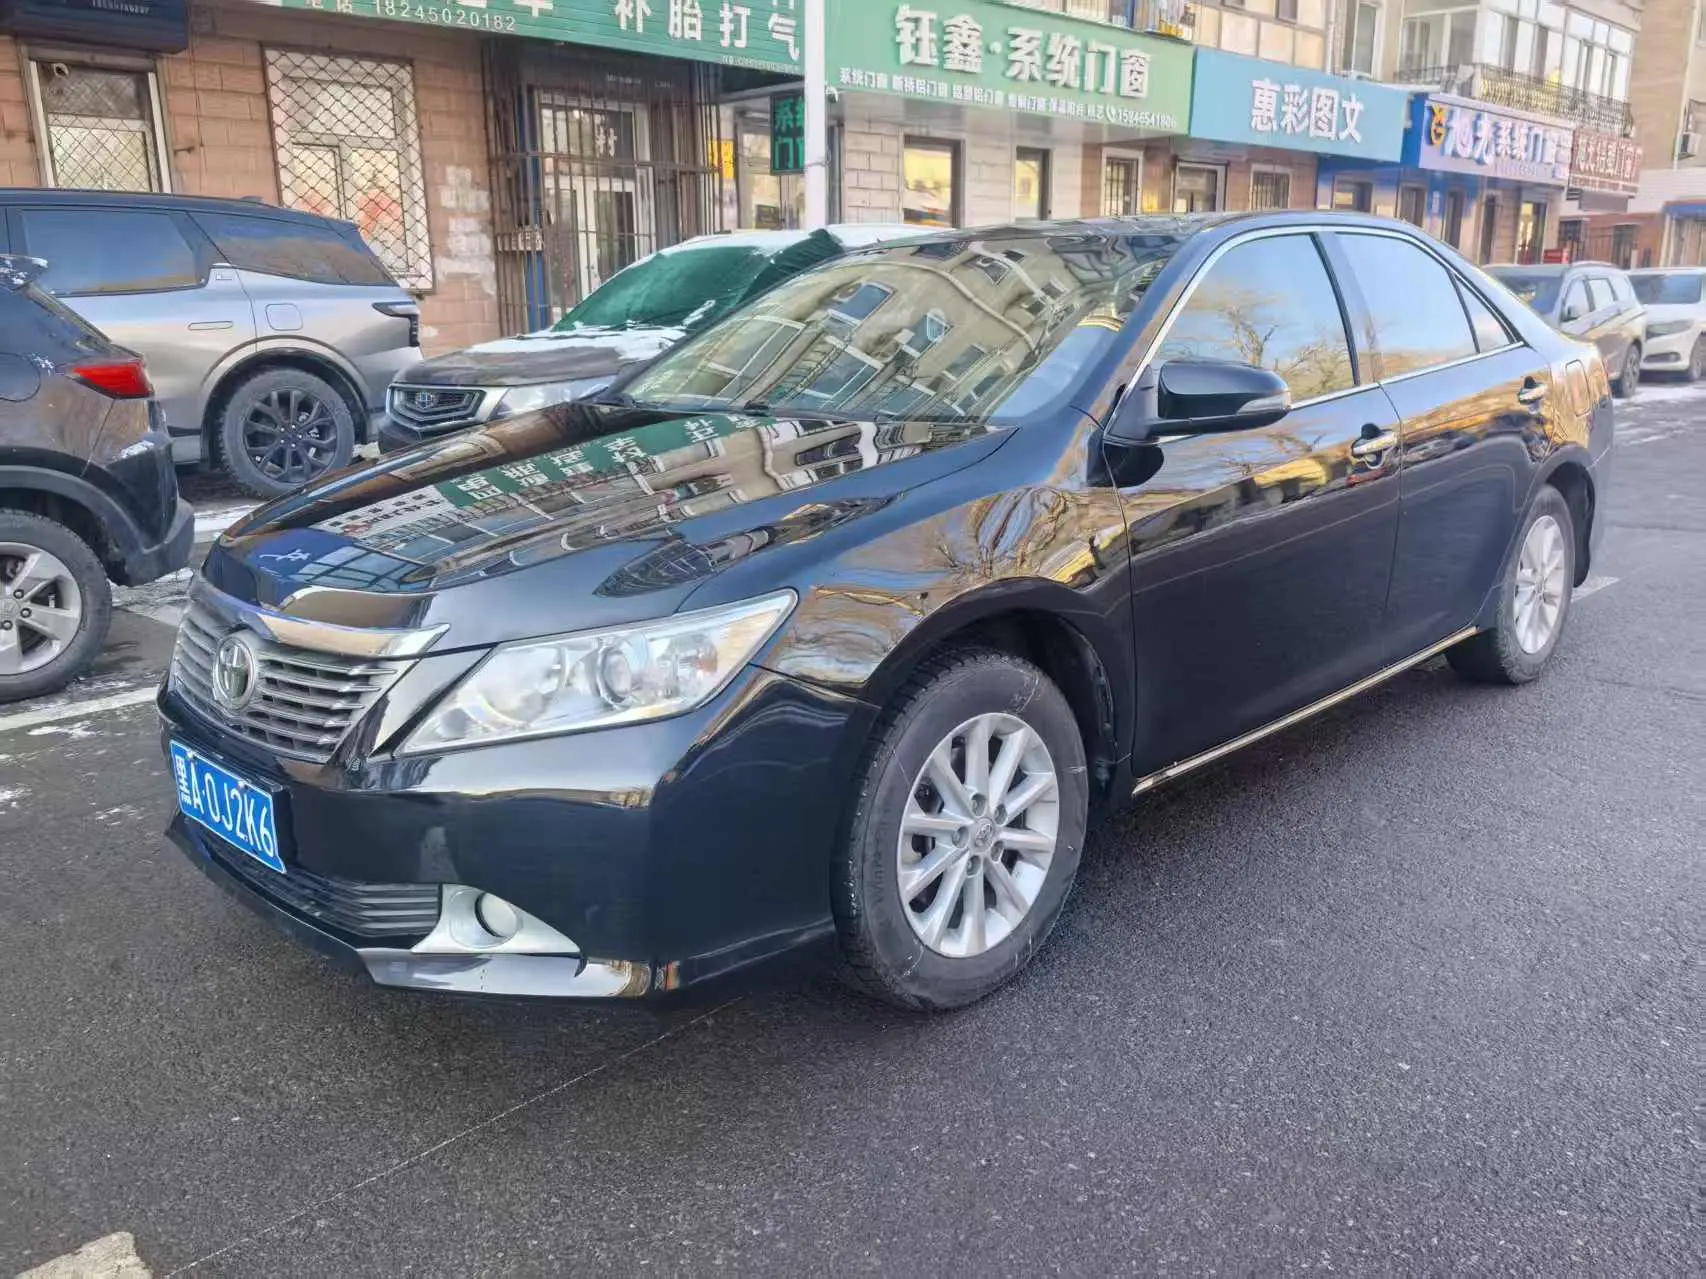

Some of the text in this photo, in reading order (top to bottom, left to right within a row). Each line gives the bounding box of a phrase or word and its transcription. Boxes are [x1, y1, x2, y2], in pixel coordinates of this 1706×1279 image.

[375, 0, 516, 31] 18245020182
[614, 0, 801, 62] 补胎打气
[839, 66, 888, 89] 系统门窗
[1251, 78, 1364, 144] 惠彩图文
